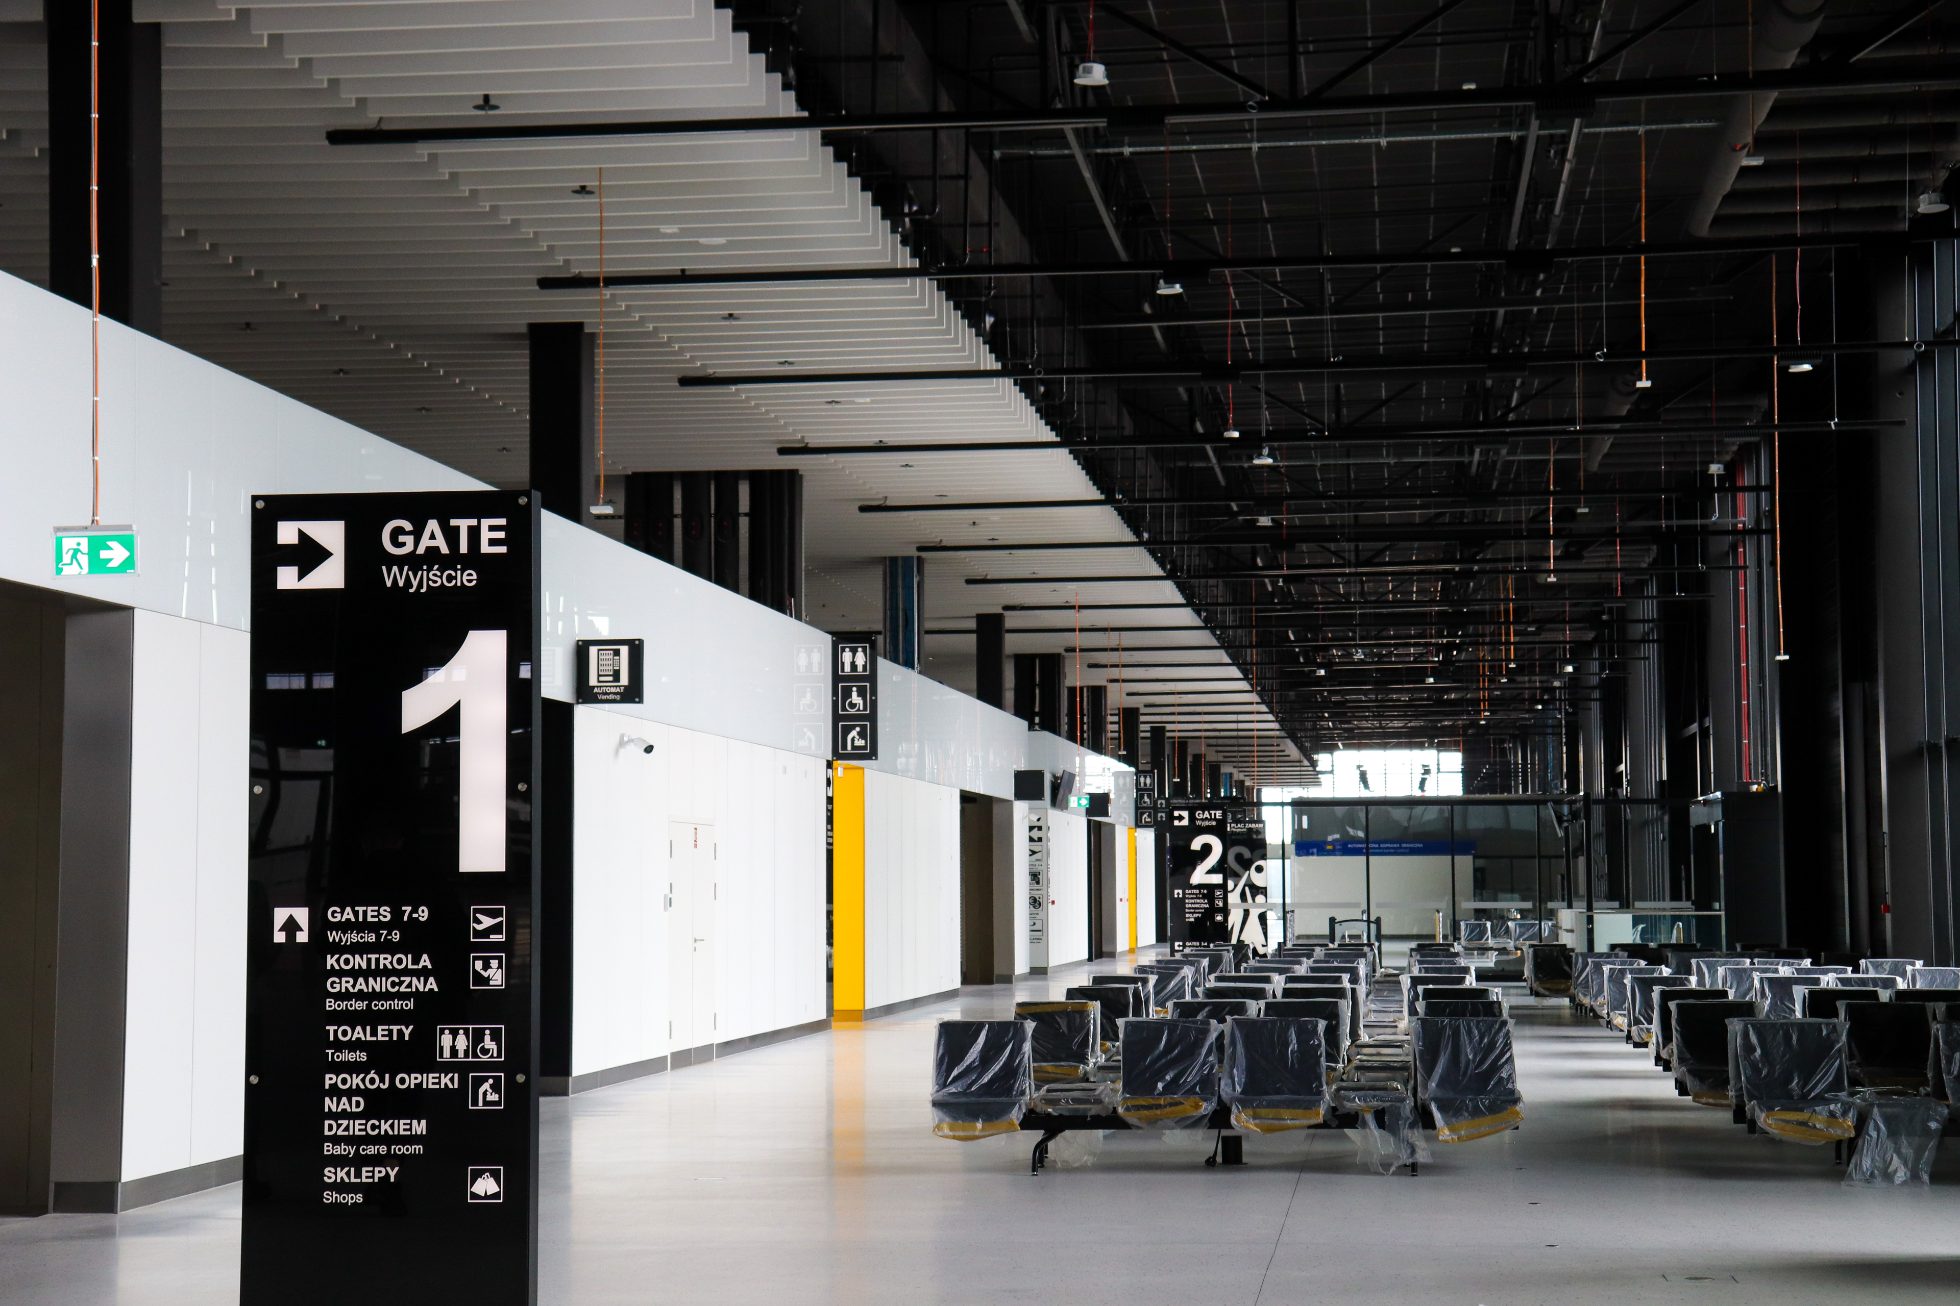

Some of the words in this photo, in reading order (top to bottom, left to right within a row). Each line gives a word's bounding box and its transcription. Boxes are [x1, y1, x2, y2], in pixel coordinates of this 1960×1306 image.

[381, 518, 508, 555] GATE
[381, 565, 478, 593] Wyjście
[401, 629, 507, 873] 1
[1195, 810, 1223, 819] GATE
[1190, 834, 1223, 885] 2
[327, 906, 391, 922] GATES
[401, 906, 429, 922] 7-9
[327, 931, 375, 945] Wyjścia
[379, 930, 400, 942] 7-9
[326, 954, 432, 970] KONTROLA
[326, 977, 438, 993] GRANICZNA
[325, 998, 368, 1010] Border
[371, 998, 414, 1011] control
[325, 1025, 414, 1041] TOALETY
[325, 1050, 367, 1062] Toilets
[324, 1070, 390, 1090] POKÓJ
[395, 1073, 459, 1089] OPIEKI
[324, 1097, 365, 1113] NAD
[324, 1120, 427, 1136] DZIECKIEM
[323, 1143, 356, 1157] Baby
[359, 1145, 387, 1155] care
[390, 1145, 424, 1155] room
[323, 1167, 400, 1183] SKLEPY
[322, 1191, 364, 1206] Shops
